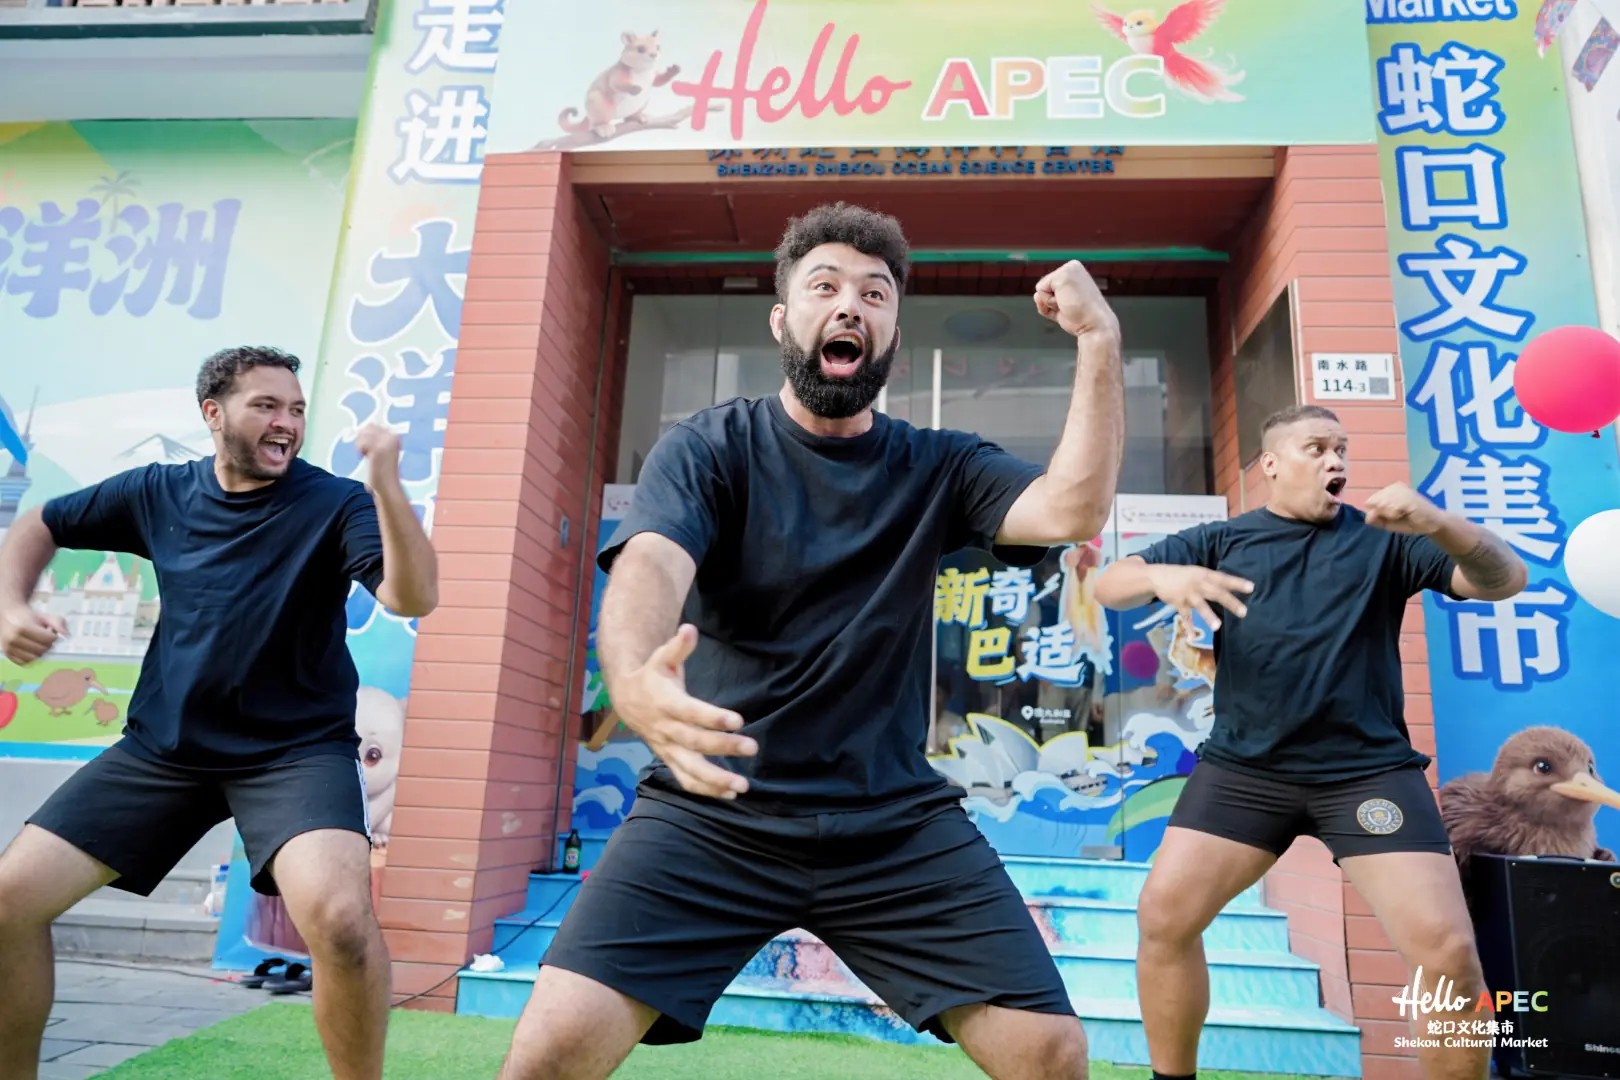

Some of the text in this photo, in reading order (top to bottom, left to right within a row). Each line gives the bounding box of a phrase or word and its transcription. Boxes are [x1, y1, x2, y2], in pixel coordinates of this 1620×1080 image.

[671, 0, 1167, 140] Hello APEC
[717, 160, 1115, 176] SHENZHEN SHEKOU OCEAN SCIENCE CENTER
[1317, 359, 1367, 371] 南水路
[1379, 44, 1566, 688] 蛇口文化集市
[935, 566, 1037, 630] 新奇
[966, 620, 1085, 688] 巴适
